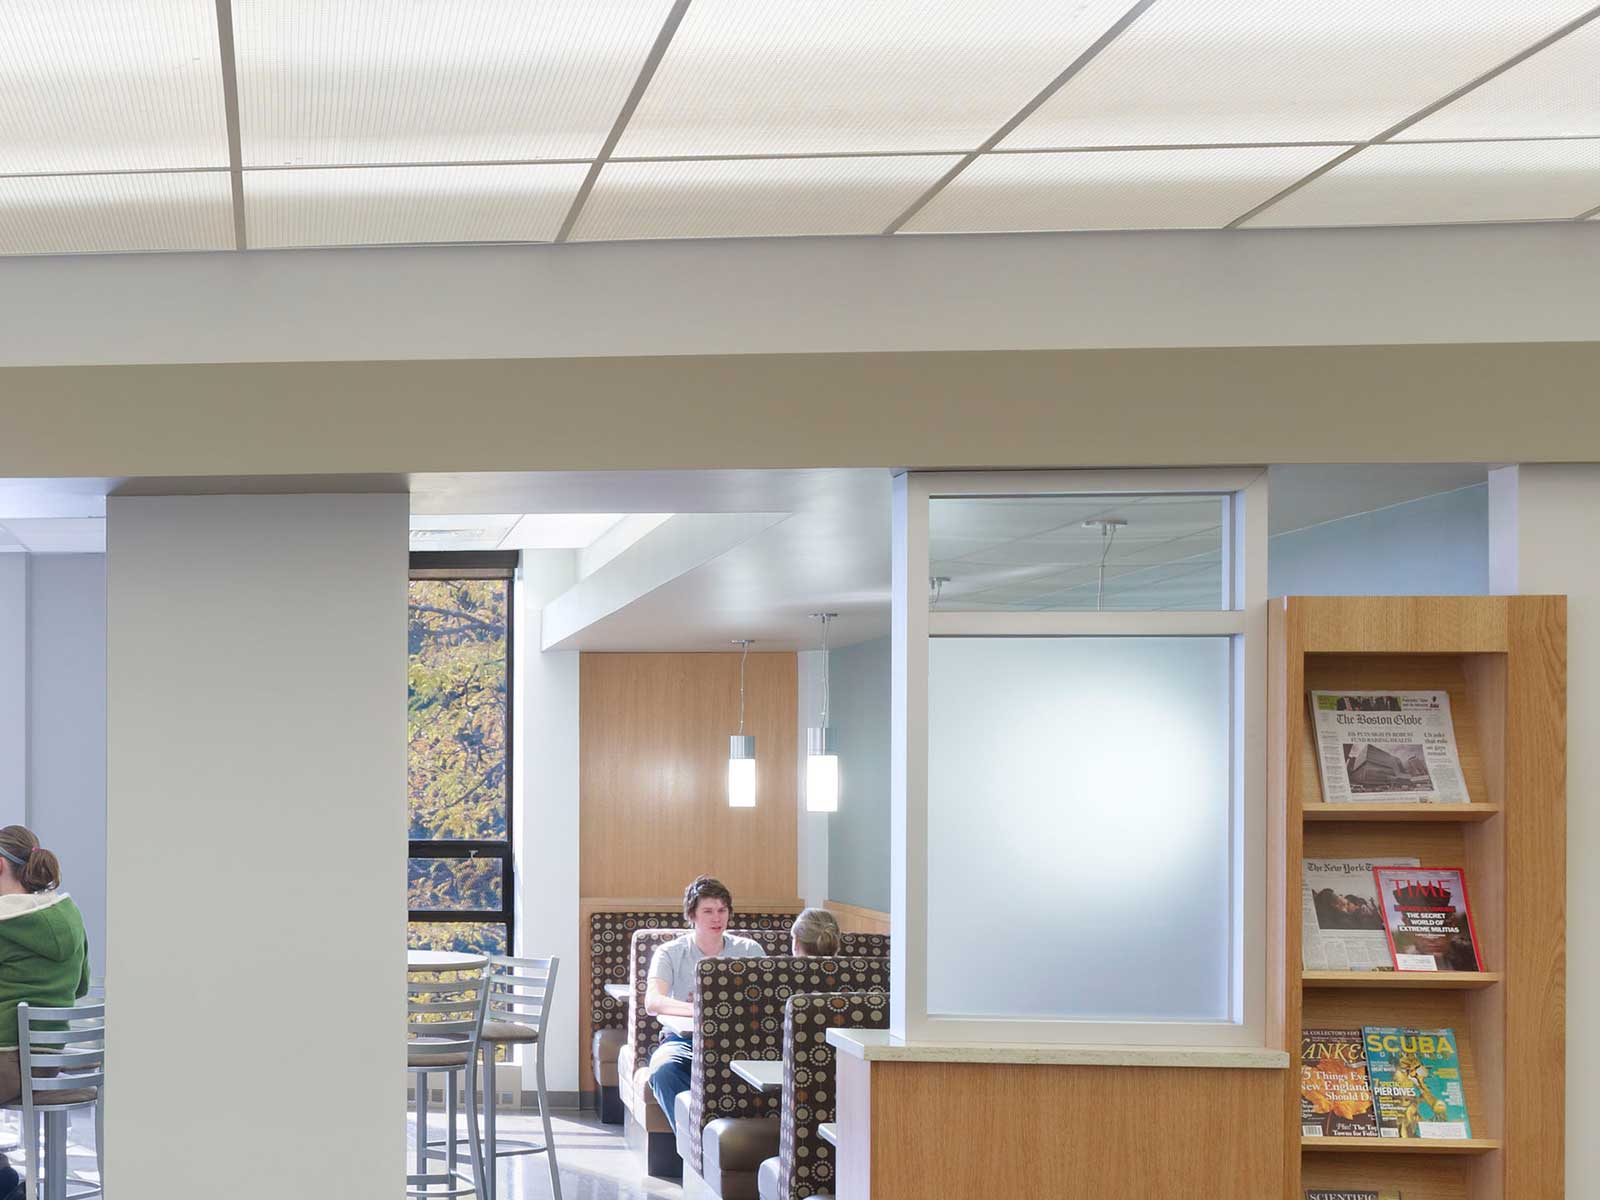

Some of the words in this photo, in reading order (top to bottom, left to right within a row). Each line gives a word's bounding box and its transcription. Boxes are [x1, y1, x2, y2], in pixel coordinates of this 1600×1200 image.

[1336, 714, 1355, 725] The
[1357, 714, 1392, 725] Boston
[1393, 715, 1423, 726] Globe
[1307, 862, 1323, 872] The
[1324, 863, 1342, 872] New
[1343, 862, 1365, 874] York
[1388, 879, 1452, 898] TIME
[1367, 1034, 1454, 1054] SCUBA
[1316, 1071, 1349, 1083] Things
[1325, 1092, 1359, 1101] Should
[1374, 1087, 1393, 1095] PIER
[1393, 1087, 1416, 1096] DIVES
